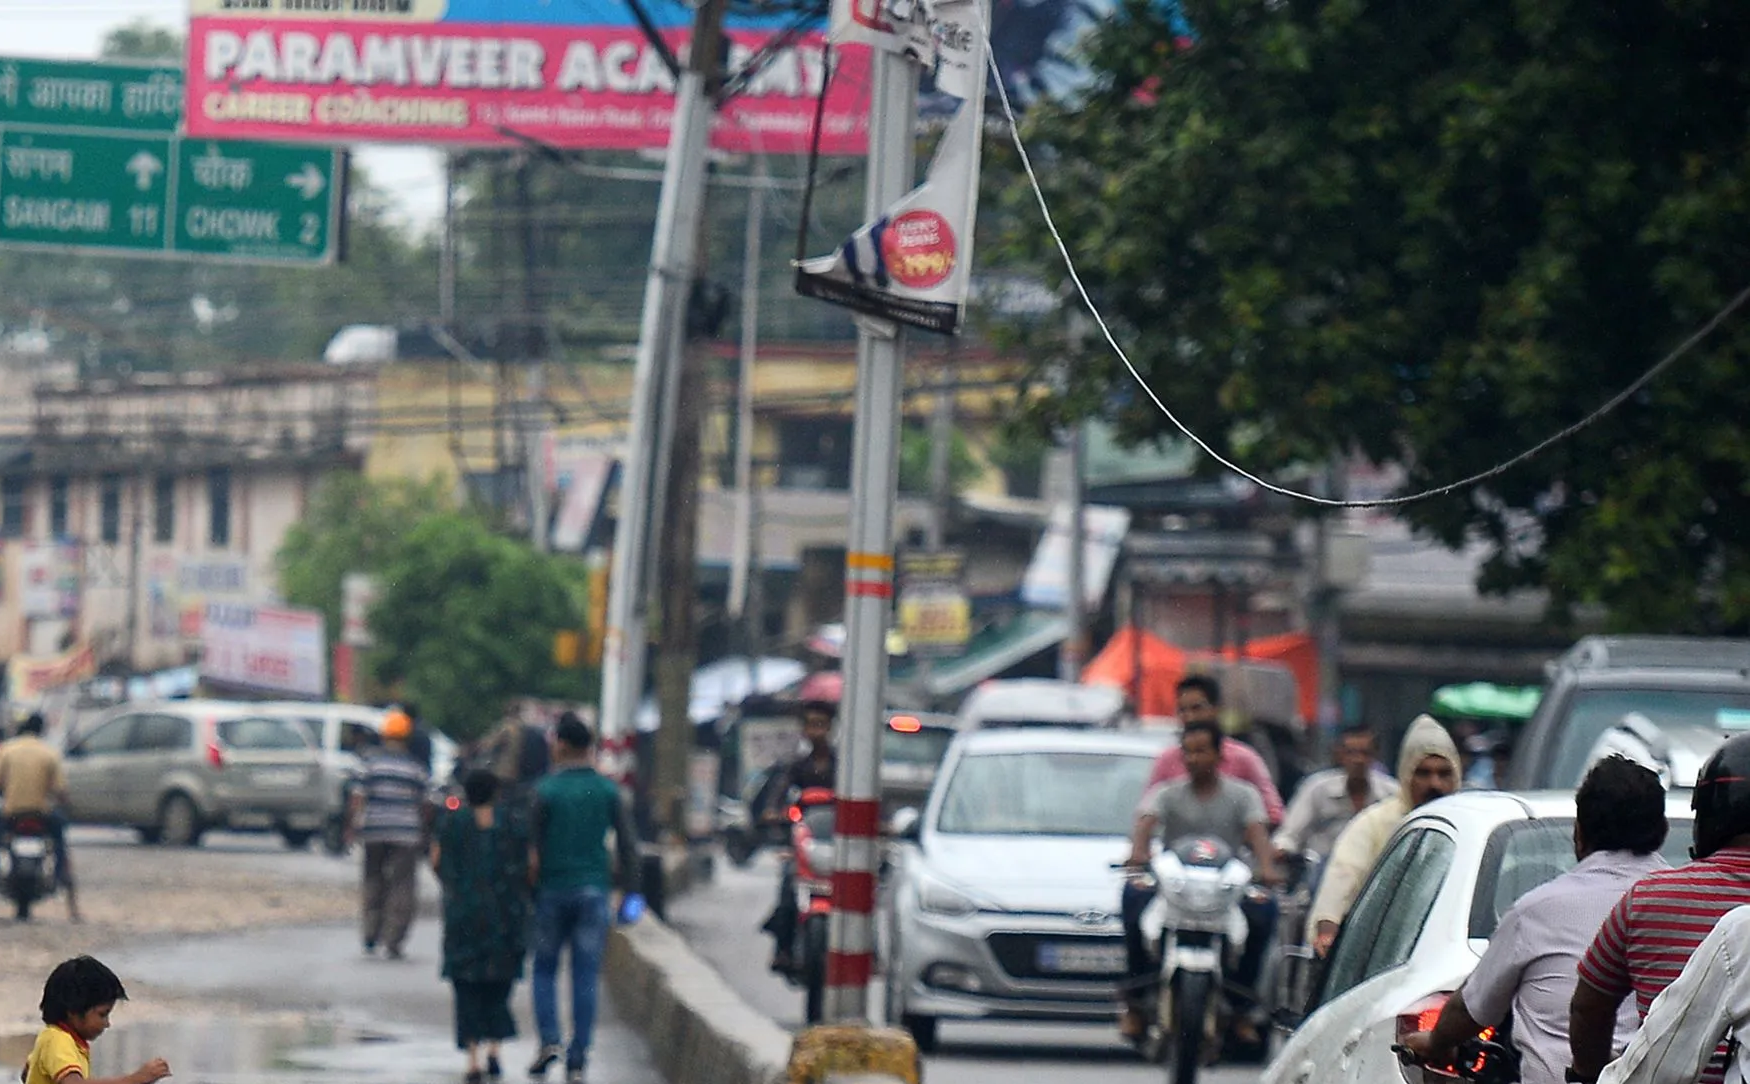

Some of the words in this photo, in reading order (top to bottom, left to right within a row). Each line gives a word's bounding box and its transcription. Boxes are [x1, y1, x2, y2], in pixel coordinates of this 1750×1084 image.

[203, 30, 547, 89] PARAMVEER
[556, 39, 840, 97] ACAMY
[203, 93, 312, 123] CAREER
[316, 96, 470, 128] COACHING
[3, 194, 111, 232] SANGAM
[127, 203, 160, 237] 11
[185, 206, 281, 240] CHOWK
[297, 212, 321, 245] 2
